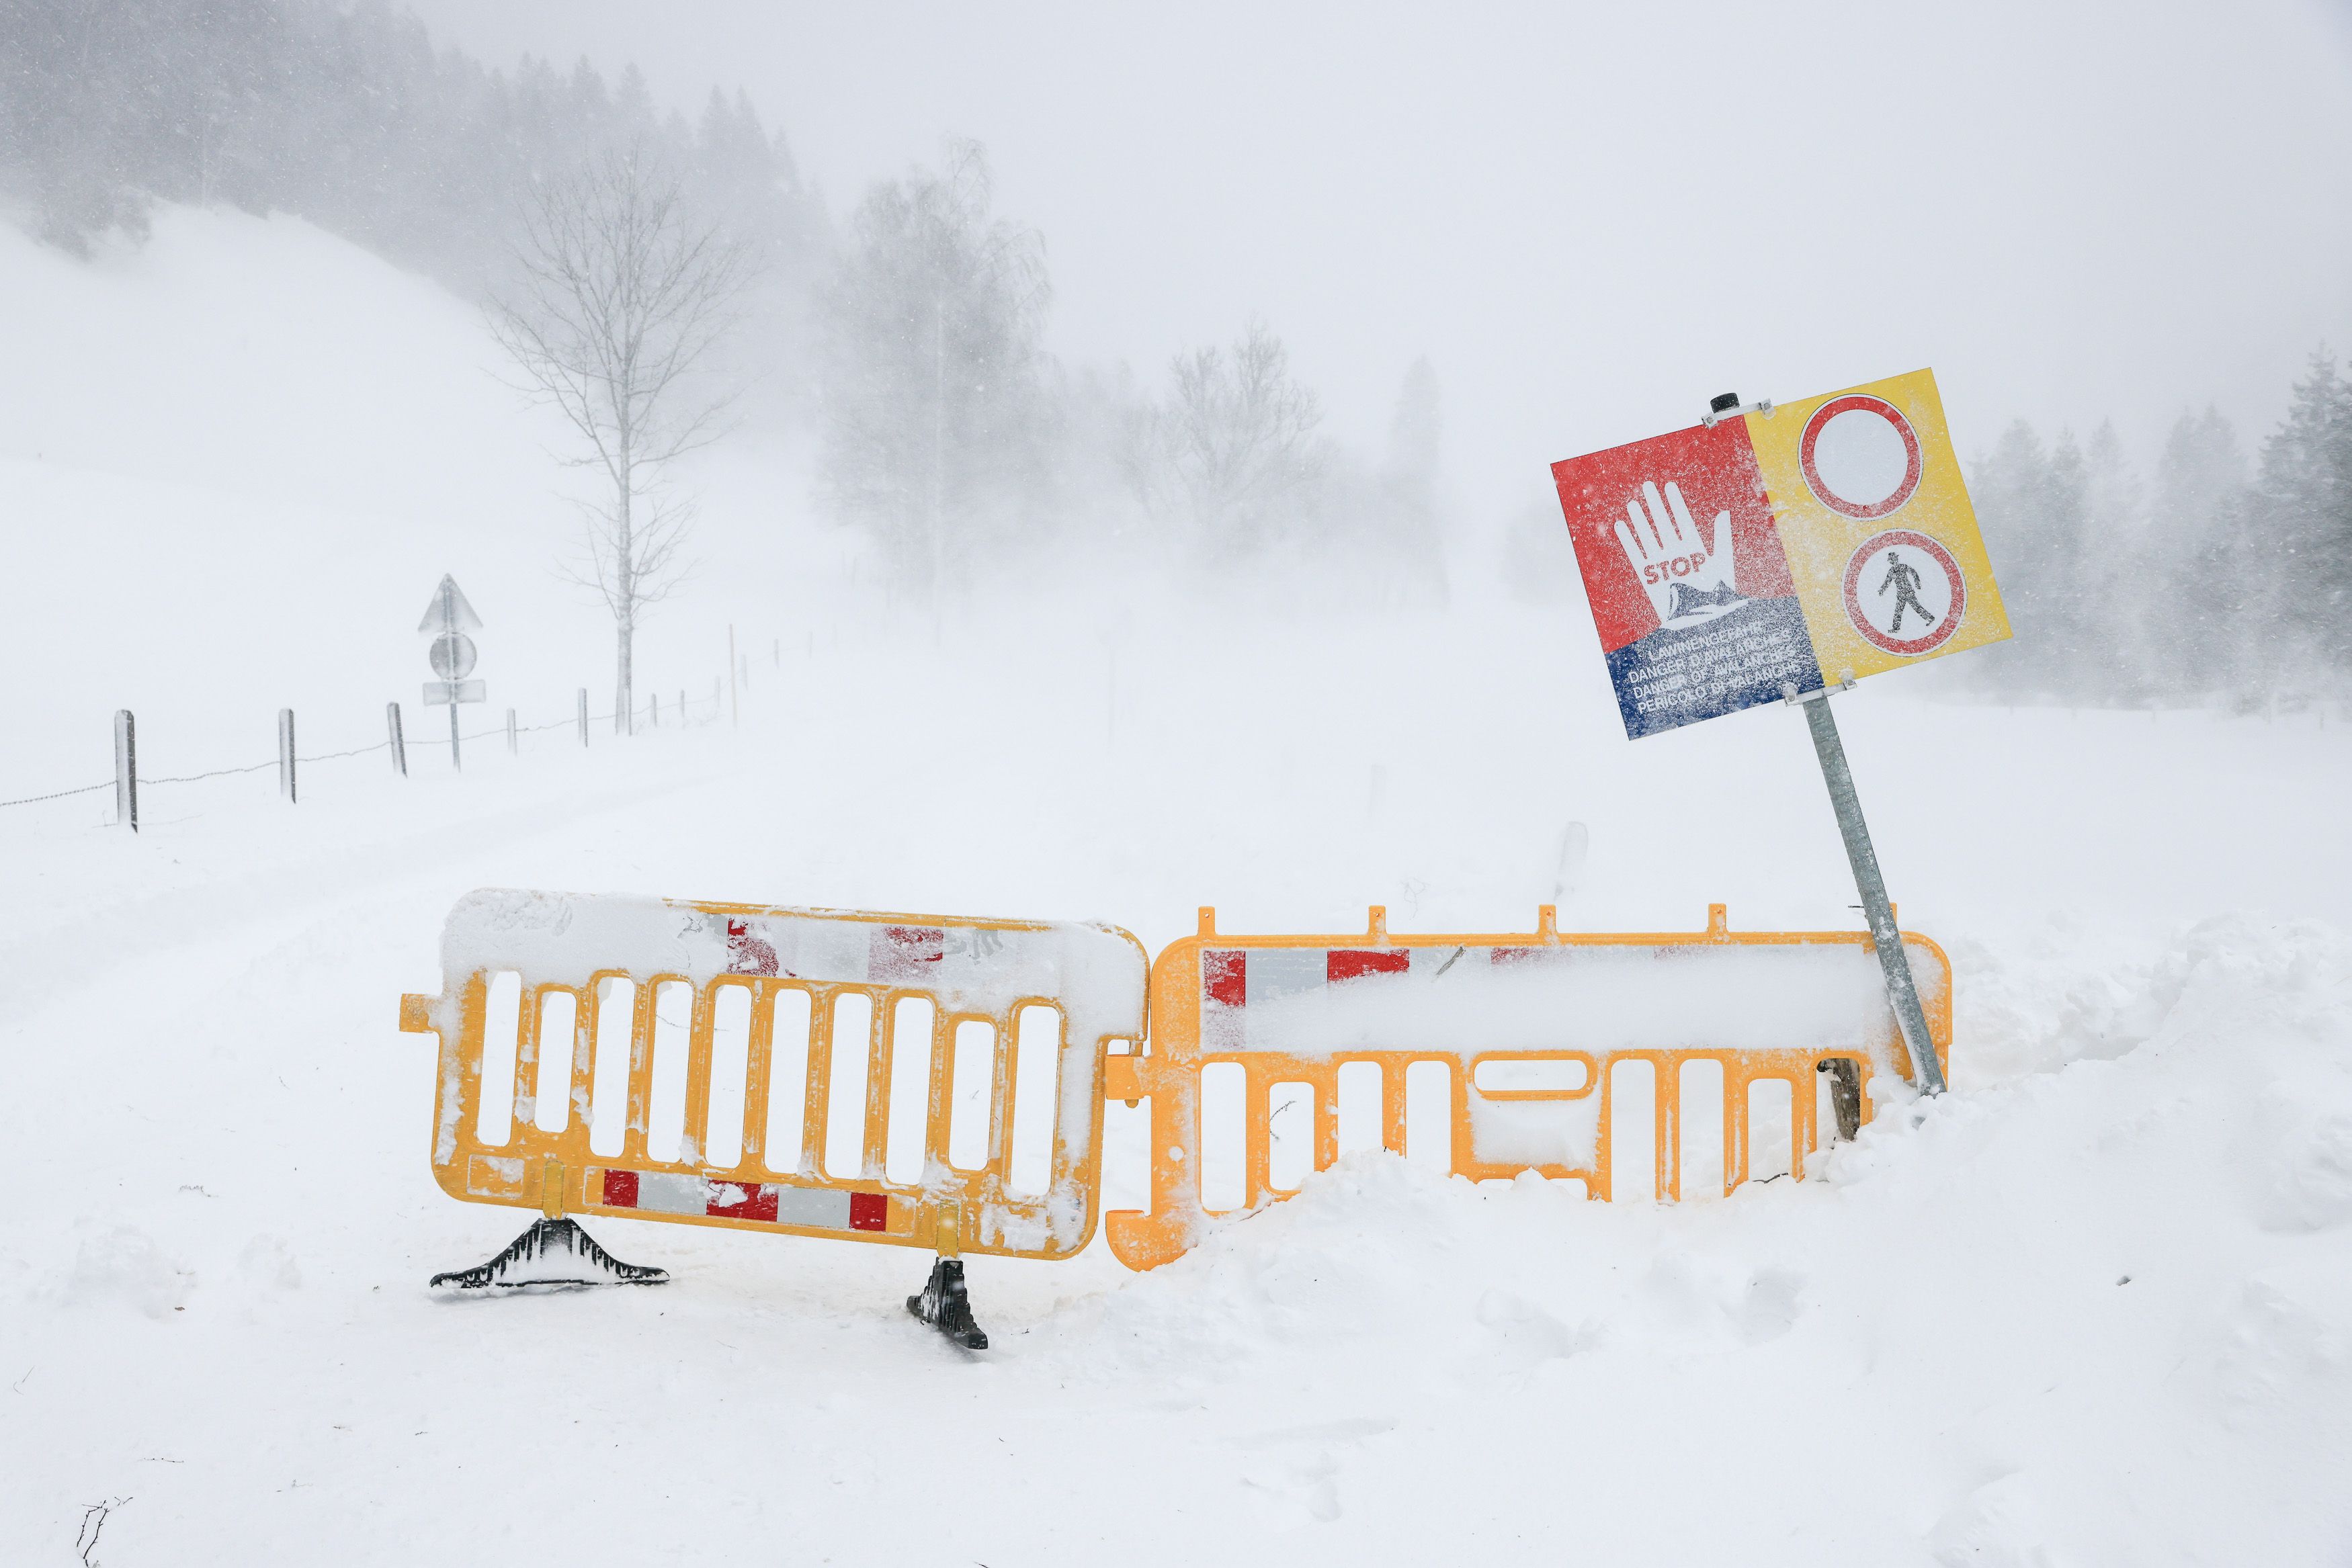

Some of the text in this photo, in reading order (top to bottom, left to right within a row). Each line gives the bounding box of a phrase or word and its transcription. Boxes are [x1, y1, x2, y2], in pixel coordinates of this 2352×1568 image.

[1644, 553, 1706, 584] STOP
[1648, 621, 1763, 662] LAWINENGEFAHR
[1629, 659, 1685, 684] DANGER
[1634, 645, 1796, 699] DANGER OF AVALANCHES
[1638, 660, 1802, 714] PERICOLO DI VALANGHE
